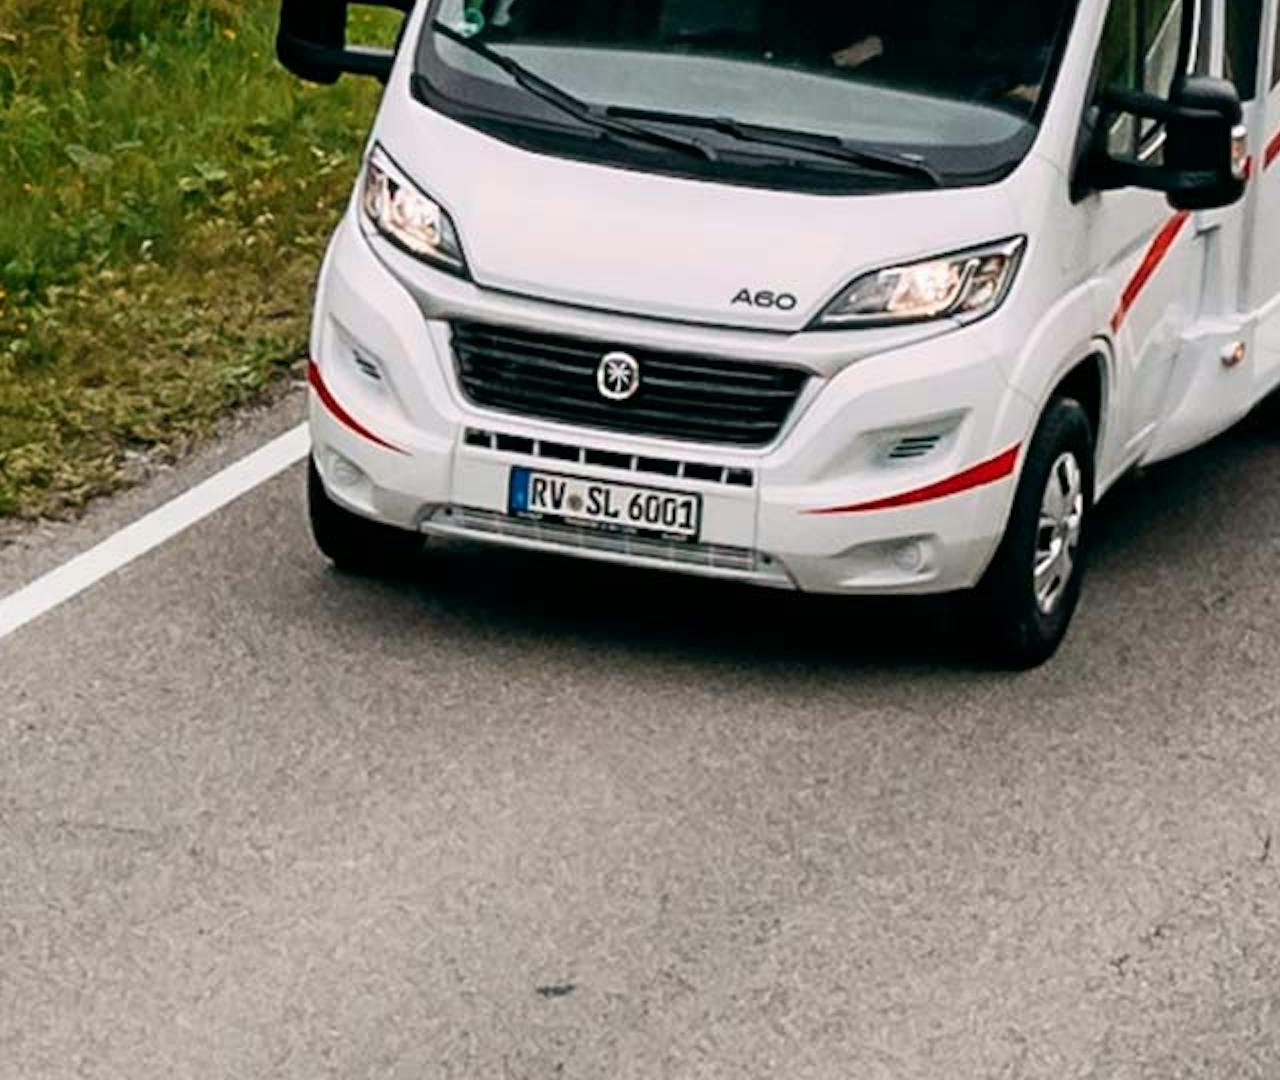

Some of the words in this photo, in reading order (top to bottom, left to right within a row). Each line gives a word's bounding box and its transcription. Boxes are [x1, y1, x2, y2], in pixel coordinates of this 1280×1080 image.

[731, 287, 797, 310] A60
[532, 478, 566, 509] RV
[587, 486, 619, 518] SL
[629, 494, 694, 529] 6001
